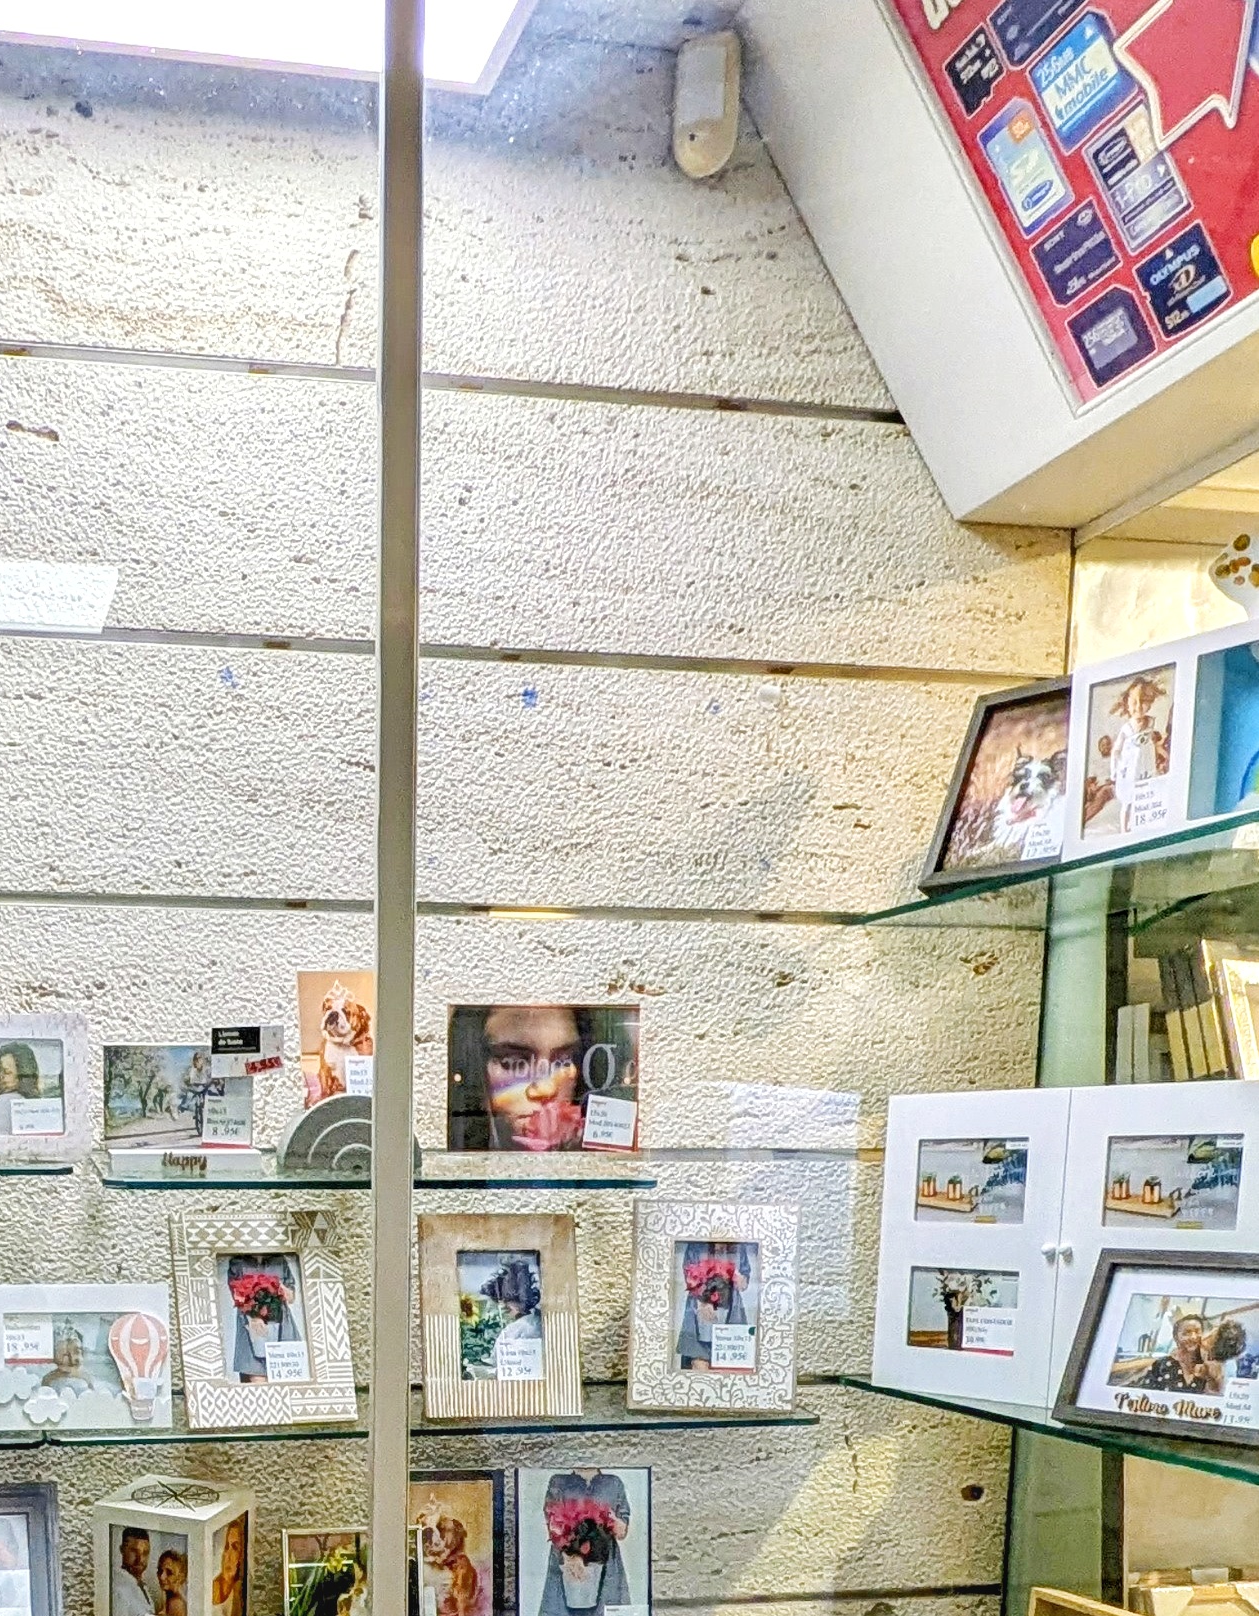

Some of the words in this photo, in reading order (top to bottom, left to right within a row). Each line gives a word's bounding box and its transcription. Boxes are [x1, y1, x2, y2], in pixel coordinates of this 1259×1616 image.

[1054, 56, 1093, 99] MMC
[1150, 244, 1200, 286] OLYMPUS
[162, 1152, 207, 1174] Happy
